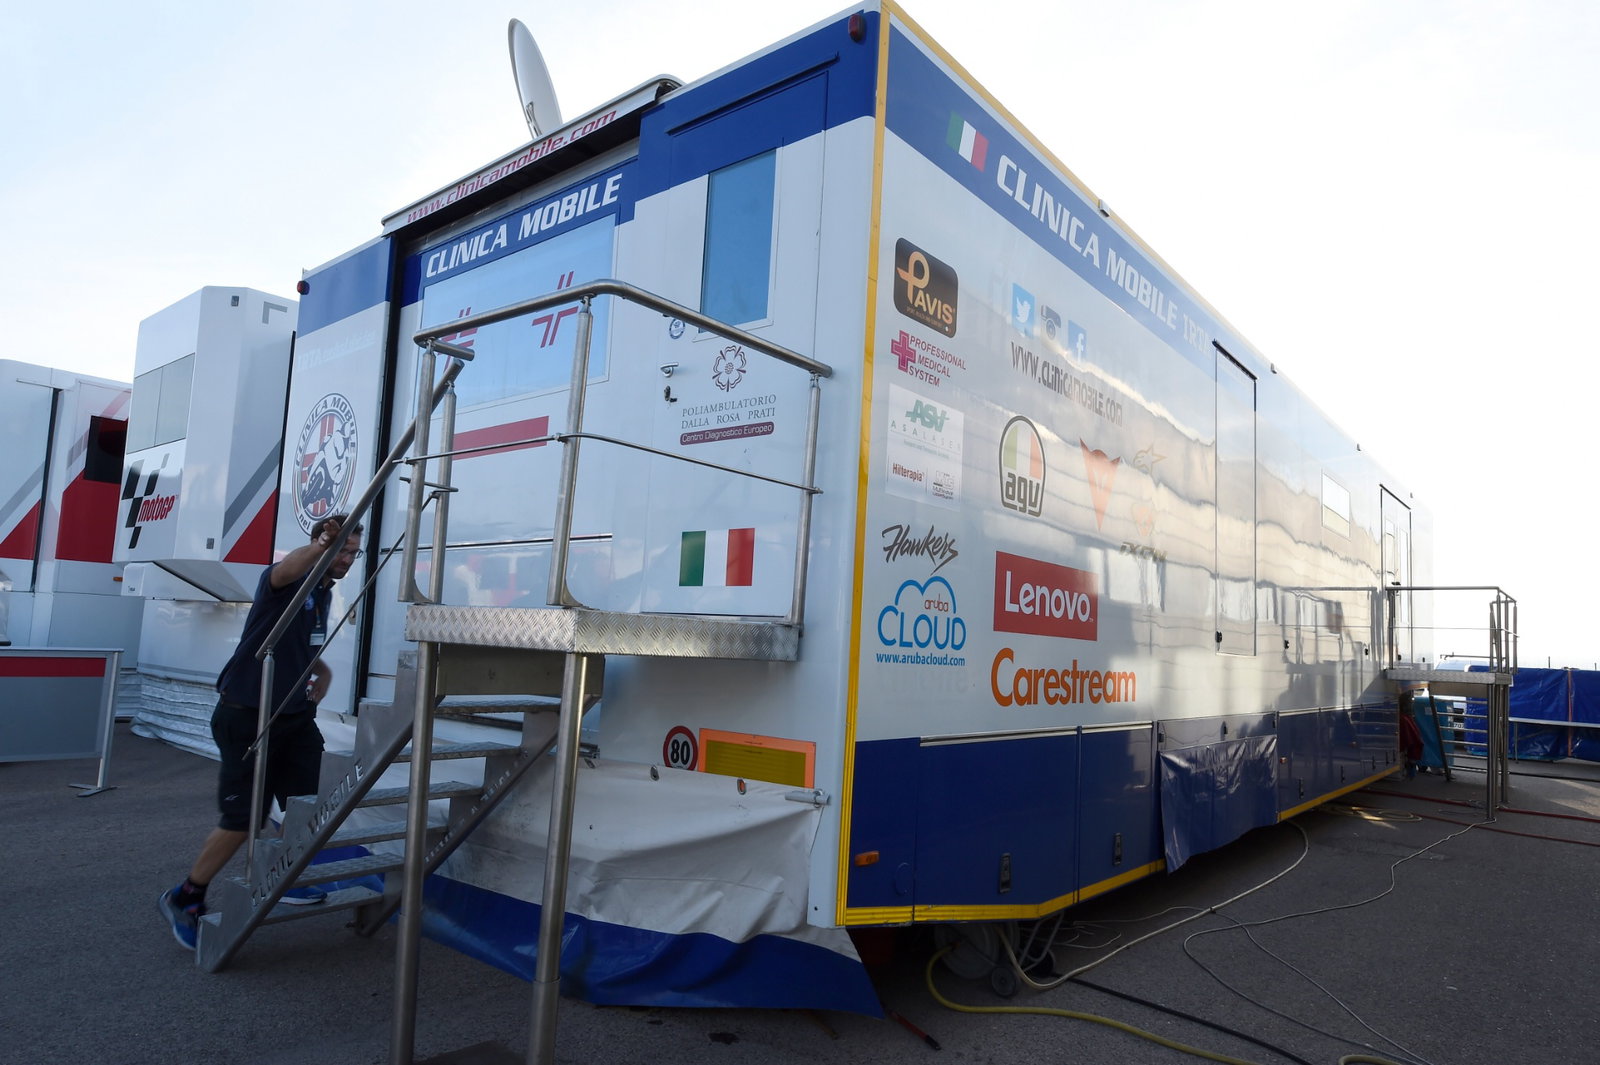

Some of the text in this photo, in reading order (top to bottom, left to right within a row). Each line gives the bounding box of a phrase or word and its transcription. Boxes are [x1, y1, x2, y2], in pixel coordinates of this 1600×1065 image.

[407, 110, 617, 223] www.clinicamobile.com
[426, 172, 623, 278] CLINICA MOBILE
[997, 154, 1100, 269] CLINICA
[1105, 247, 1178, 331] MOBILE
[910, 335, 967, 371] PROFESSIONAL
[918, 354, 951, 378] MEDICAL
[909, 365, 940, 388] SYSTEM
[681, 407, 776, 430] DALLA ROSA PRATI
[682, 394, 777, 417] POLIAMBULATORIO
[682, 424, 773, 443] Centro Diagnostico Europeo
[1005, 472, 1040, 513] agv
[882, 524, 959, 576] Hawkers
[924, 593, 949, 612] aruba
[1005, 570, 1091, 622] Lenovo
[878, 605, 967, 650] CLOUD
[876, 652, 966, 666] www.arubacloud.com
[991, 647, 1136, 707] Carestream
[670, 739, 691, 765] 80
